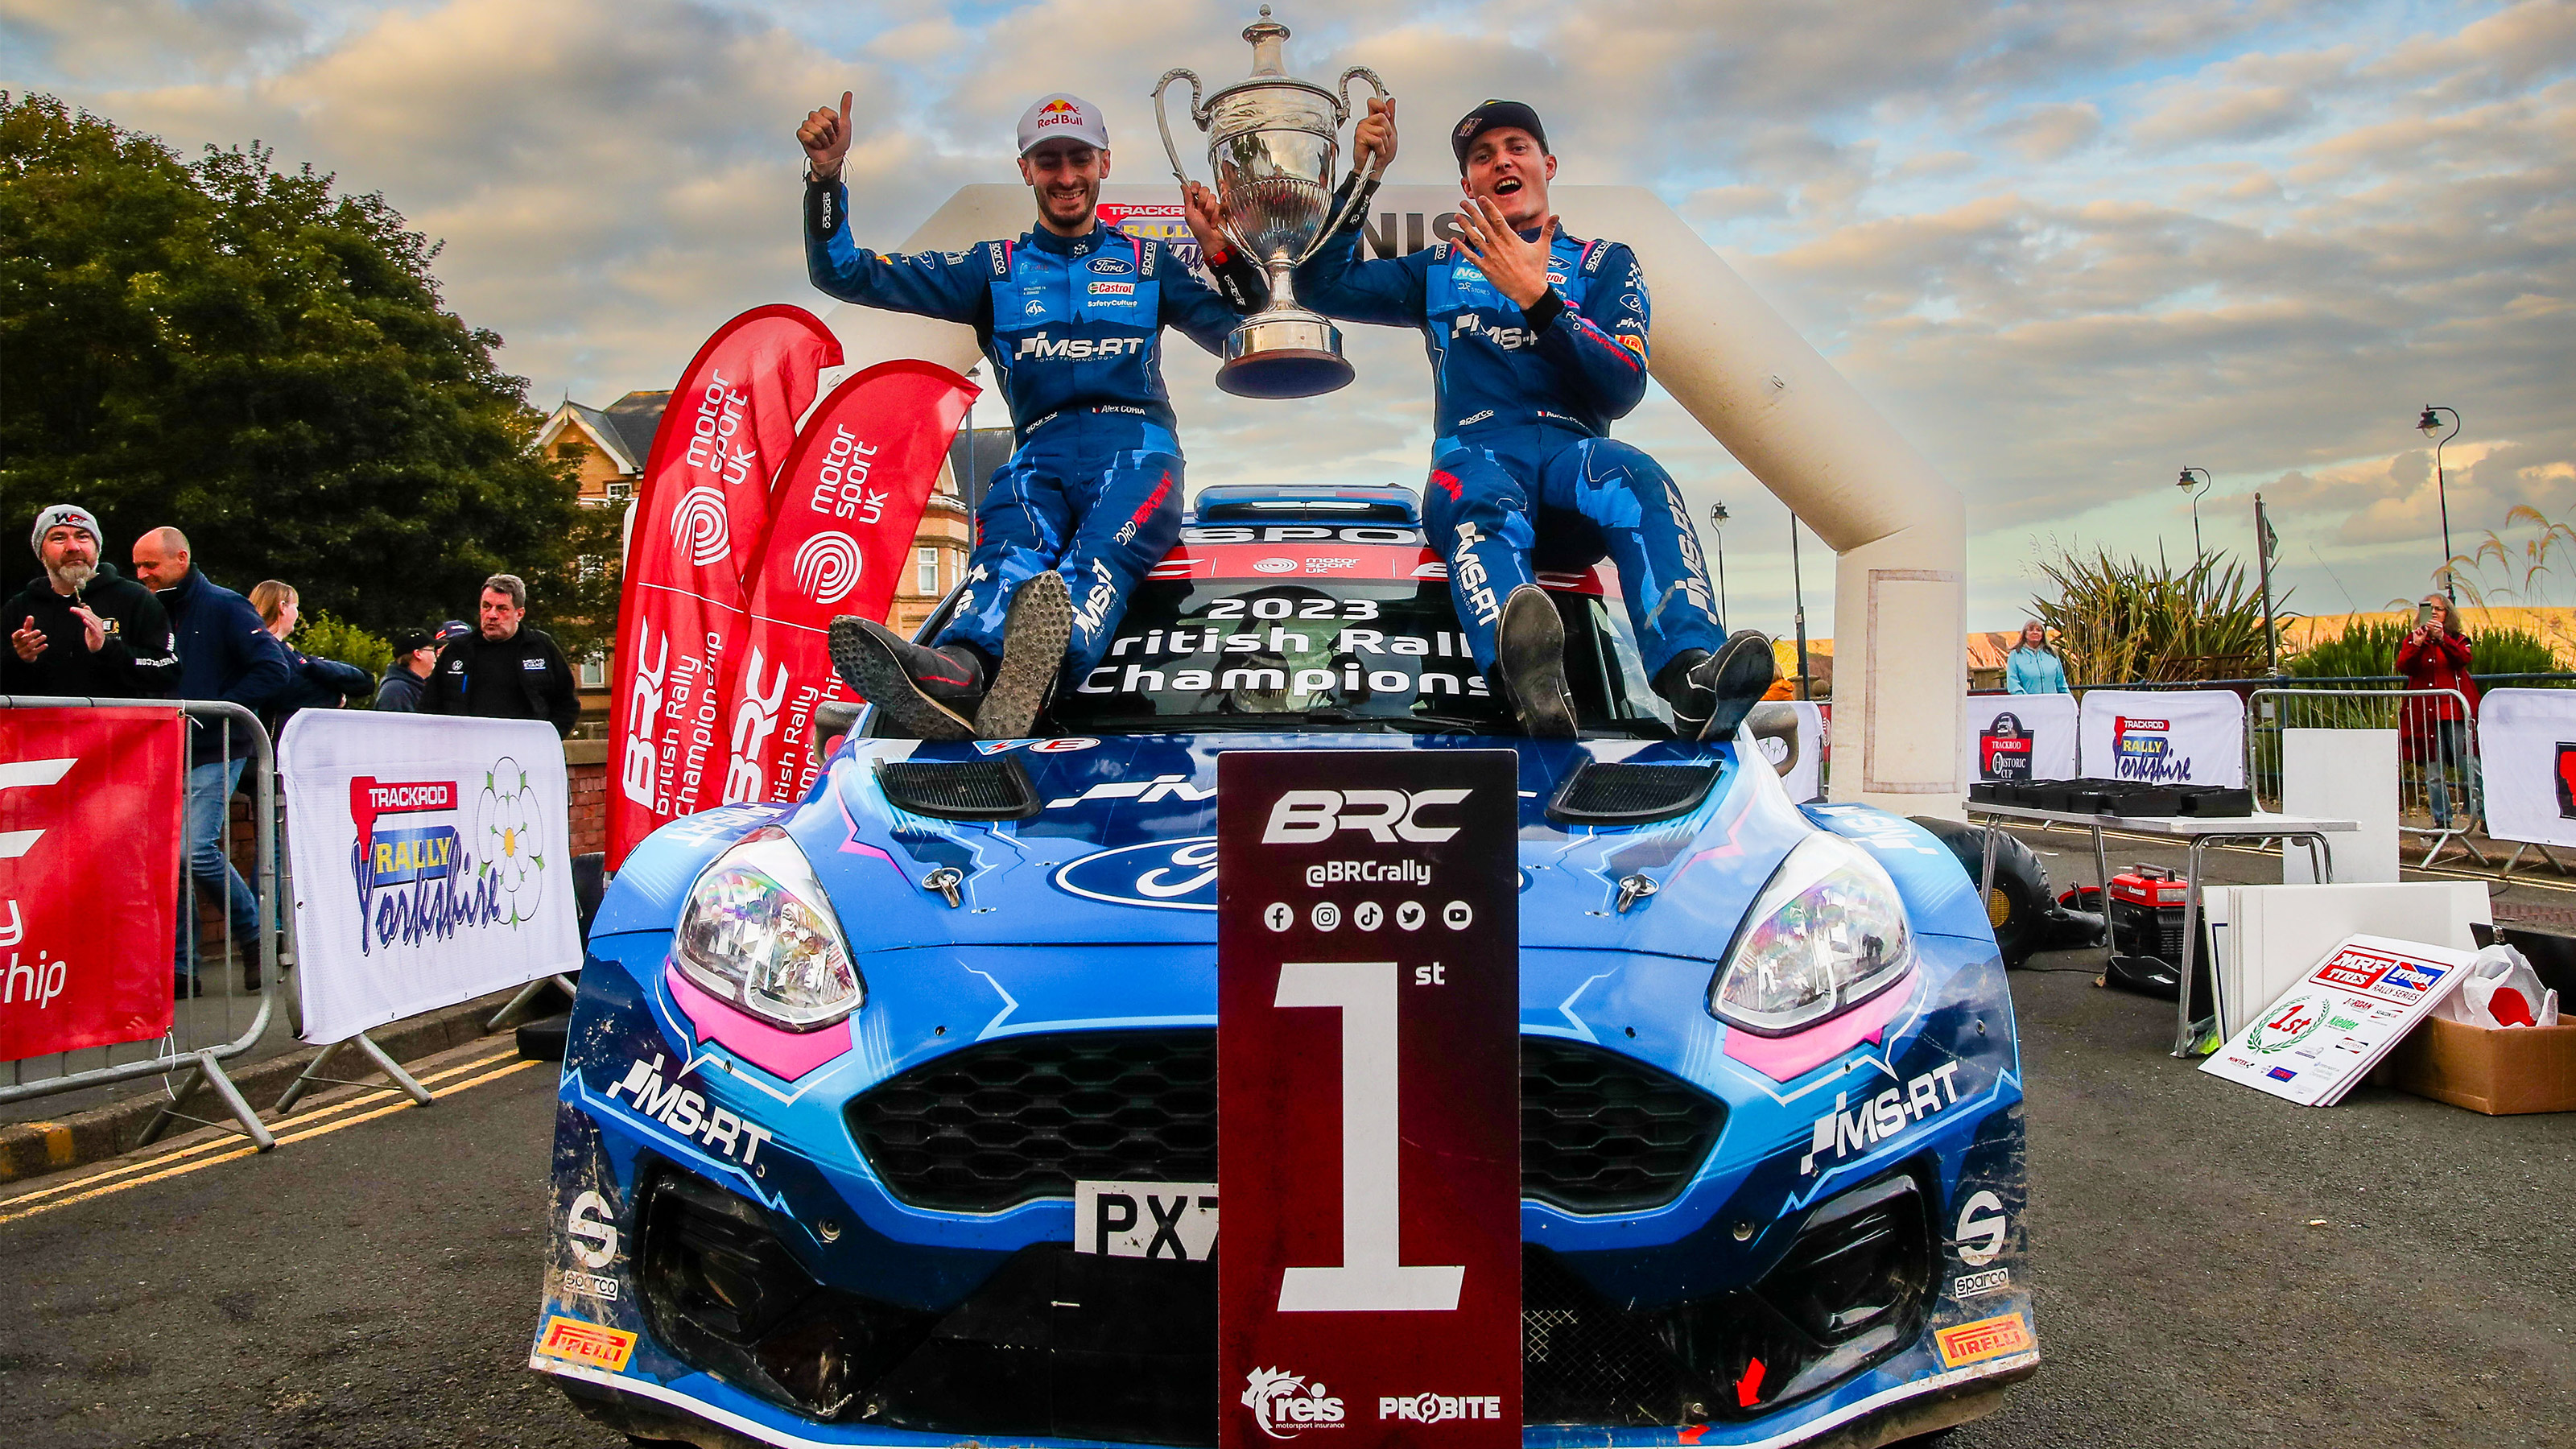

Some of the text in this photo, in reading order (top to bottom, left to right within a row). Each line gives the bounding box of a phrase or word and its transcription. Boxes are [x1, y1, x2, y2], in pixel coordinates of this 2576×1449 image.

[1037, 114, 1083, 129] Red Bull
[823, 192, 831, 229] sparco
[1108, 206, 1185, 216] TRACKR
[1354, 213, 1477, 262] NIS
[989, 242, 1006, 275] sparco
[1093, 259, 1125, 273] Ford
[1141, 242, 1157, 276] sparco
[1585, 242, 1612, 273] sparco
[1088, 299, 1137, 308] SafetyCulture
[1099, 283, 1133, 294] Castrol
[1034, 337, 1144, 358] MS-RT
[686, 369, 729, 468] motor
[1101, 405, 1119, 413] Alex
[1459, 410, 1494, 426] sparco
[709, 389, 748, 473] sport
[722, 444, 757, 485] UK
[811, 423, 856, 514] motor
[836, 441, 877, 519] sport
[859, 488, 889, 524] UK
[1114, 520, 1137, 546] ORD
[1183, 528, 1418, 543] SPO
[1455, 538, 1501, 626] MS-RT
[1208, 598, 1379, 620] 2023
[1112, 628, 1474, 658] ritish Rall
[666, 654, 703, 720] Rally
[1076, 663, 1491, 697] Champions
[622, 615, 669, 810] BRC
[722, 645, 789, 806] BRC
[2124, 720, 2164, 729] TRACKROD
[770, 752, 796, 804] itish
[783, 685, 819, 744] Rally
[1992, 741, 2021, 749] TRACKROD
[2112, 735, 2191, 782] Yorkshire
[2123, 740, 2163, 753] RALLY
[1993, 753, 2026, 773] HISTORIC
[2001, 769, 2013, 778] CUP
[369, 785, 448, 808] TRACKROD
[1261, 788, 1473, 844] BRC
[376, 836, 452, 874] RALLY
[1306, 859, 1430, 887] @BRCrally
[352, 830, 501, 956] Yorkshire
[2326, 968, 2371, 985] TYRES
[2331, 952, 2393, 974] MRF
[2372, 984, 2420, 1001] RALLY SERIES
[2267, 1005, 2312, 1034] 1st
[2327, 1015, 2360, 1031] Kielder
[631, 1071, 773, 1166] MS-RT
[1836, 1059, 1959, 1159] MS-RT
[1273, 961, 1465, 1311] 1 st
[568, 1190, 618, 1269] S
[1956, 1191, 2006, 1266] S
[565, 1273, 617, 1295] sparco
[1956, 1270, 2007, 1294] sparco
[547, 1323, 628, 1362] PIRELLI
[1943, 1320, 2022, 1359] PIRELLI
[1276, 1382, 1501, 1424] reis PROBITE
[1276, 1422, 1313, 1430] motorsport
